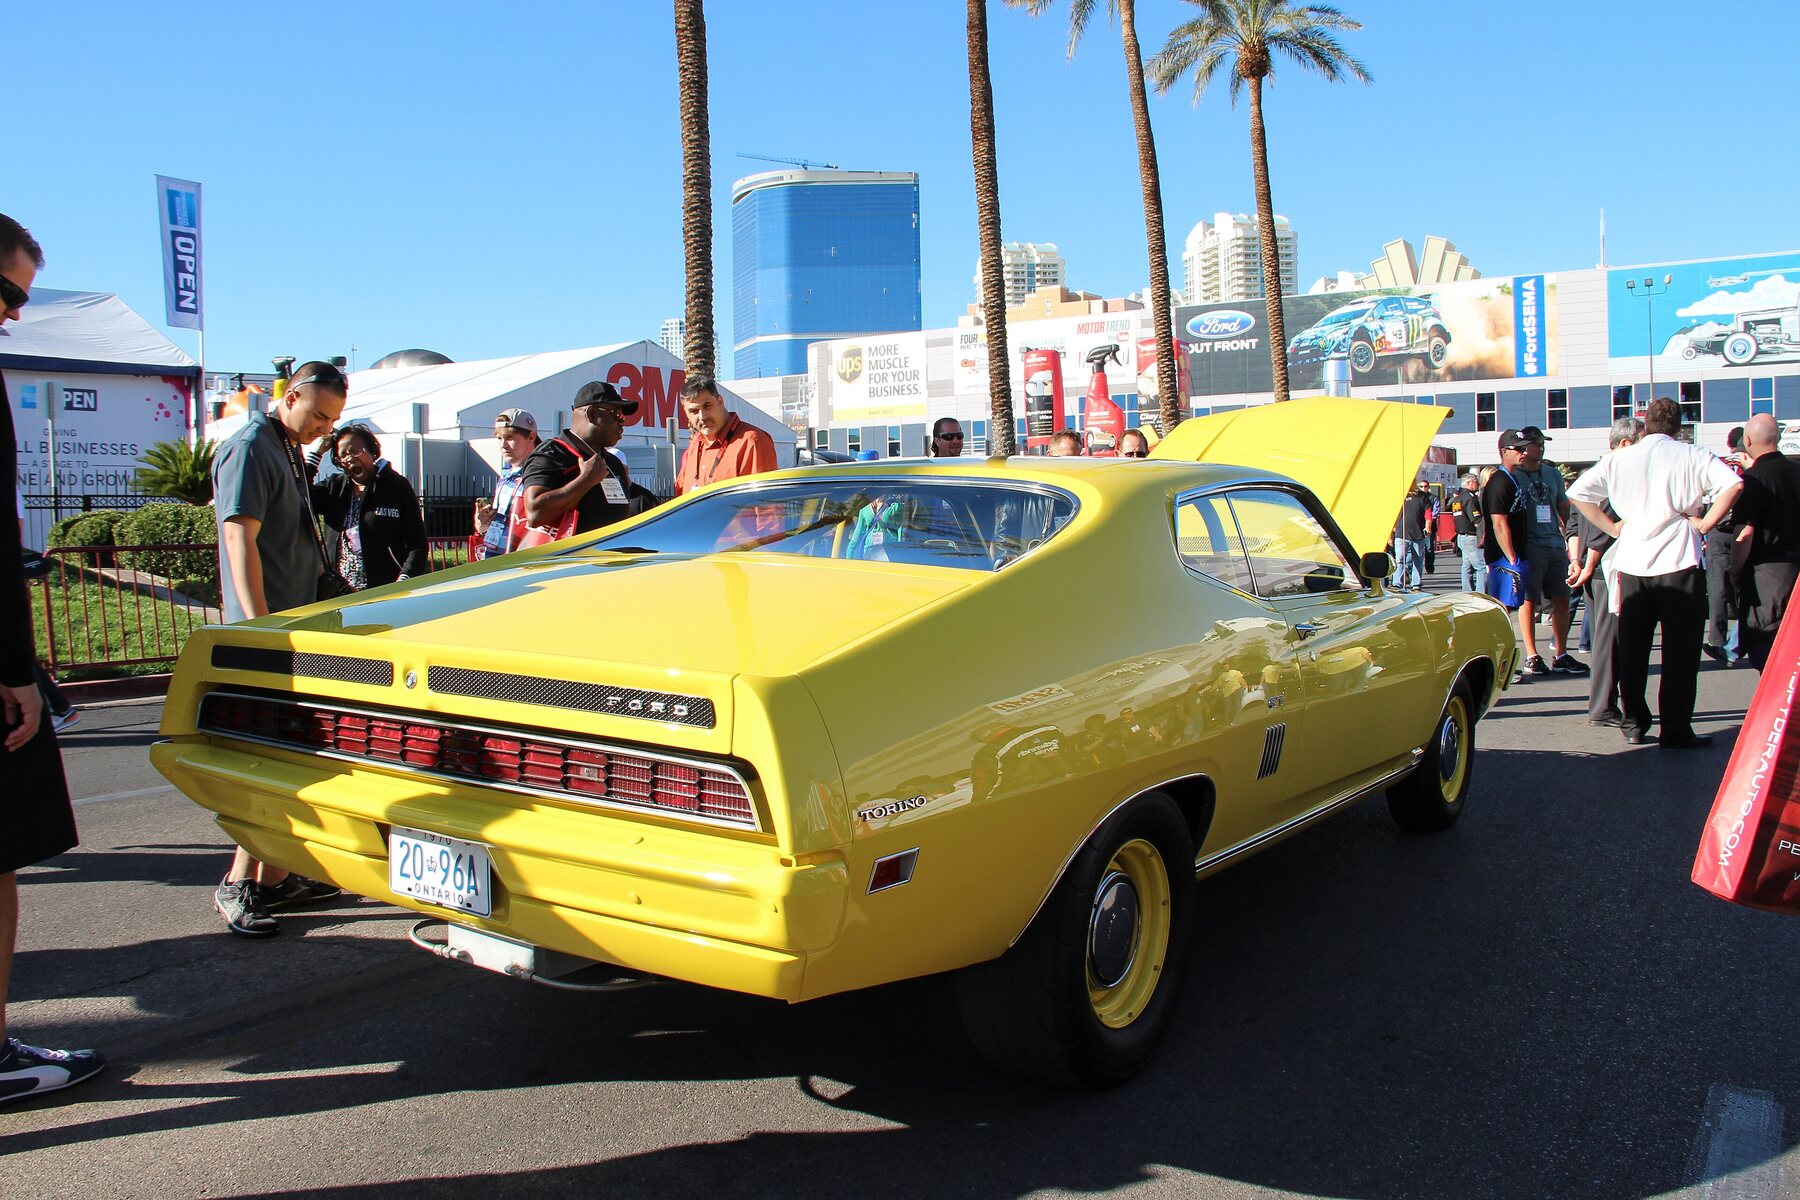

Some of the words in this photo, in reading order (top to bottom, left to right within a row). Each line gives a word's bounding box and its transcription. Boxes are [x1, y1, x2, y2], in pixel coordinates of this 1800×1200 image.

[175, 236, 197, 309] OPEN
[1077, 321, 1105, 334] MOTOR
[1106, 319, 1131, 332] TREND
[1199, 314, 1241, 334] Ford
[1522, 278, 1538, 375] #FordSEMA
[868, 344, 899, 357] MORE
[1214, 338, 1259, 353] FRONT
[837, 356, 862, 379] ups
[868, 357, 910, 371] MUSCLE
[868, 373, 889, 384] FOR
[891, 369, 920, 383] YOUR
[607, 362, 689, 430] 3M
[868, 383, 922, 398] BUSINESS.
[64, 390, 95, 409] PEN
[1139, 412, 1159, 421] Clay
[43, 428, 77, 437] GVING
[32, 460, 38, 468] A
[76, 460, 89, 469] TO
[84, 473, 130, 487] GROW
[375, 506, 387, 516] LAS
[606, 696, 689, 716] FORD
[860, 795, 927, 821] TORINO
[399, 840, 424, 881] 20
[439, 849, 479, 897] 96A
[414, 883, 464, 905] ONTARIO
